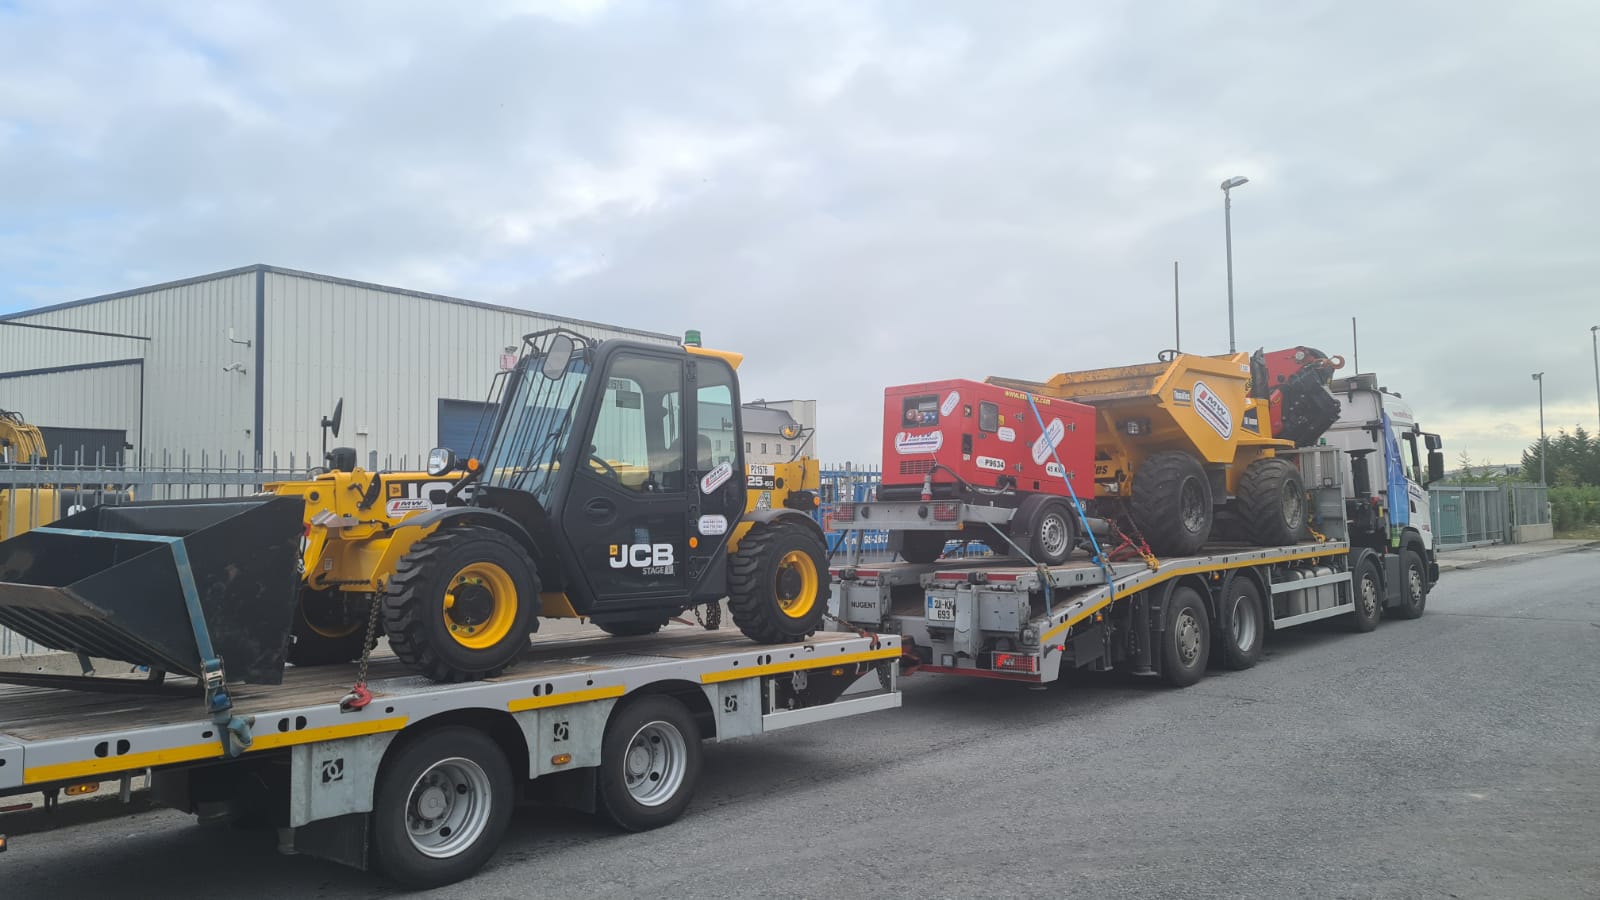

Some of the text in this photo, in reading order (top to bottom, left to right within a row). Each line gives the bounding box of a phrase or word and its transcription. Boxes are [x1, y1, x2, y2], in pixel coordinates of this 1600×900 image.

[984, 459, 1004, 468] P9634
[1047, 465, 1064, 474] 45 KV
[609, 543, 674, 569] JCB
[642, 566, 664, 575] STAGE
[851, 601, 876, 609] NUGENT
[937, 609, 951, 620] 693
